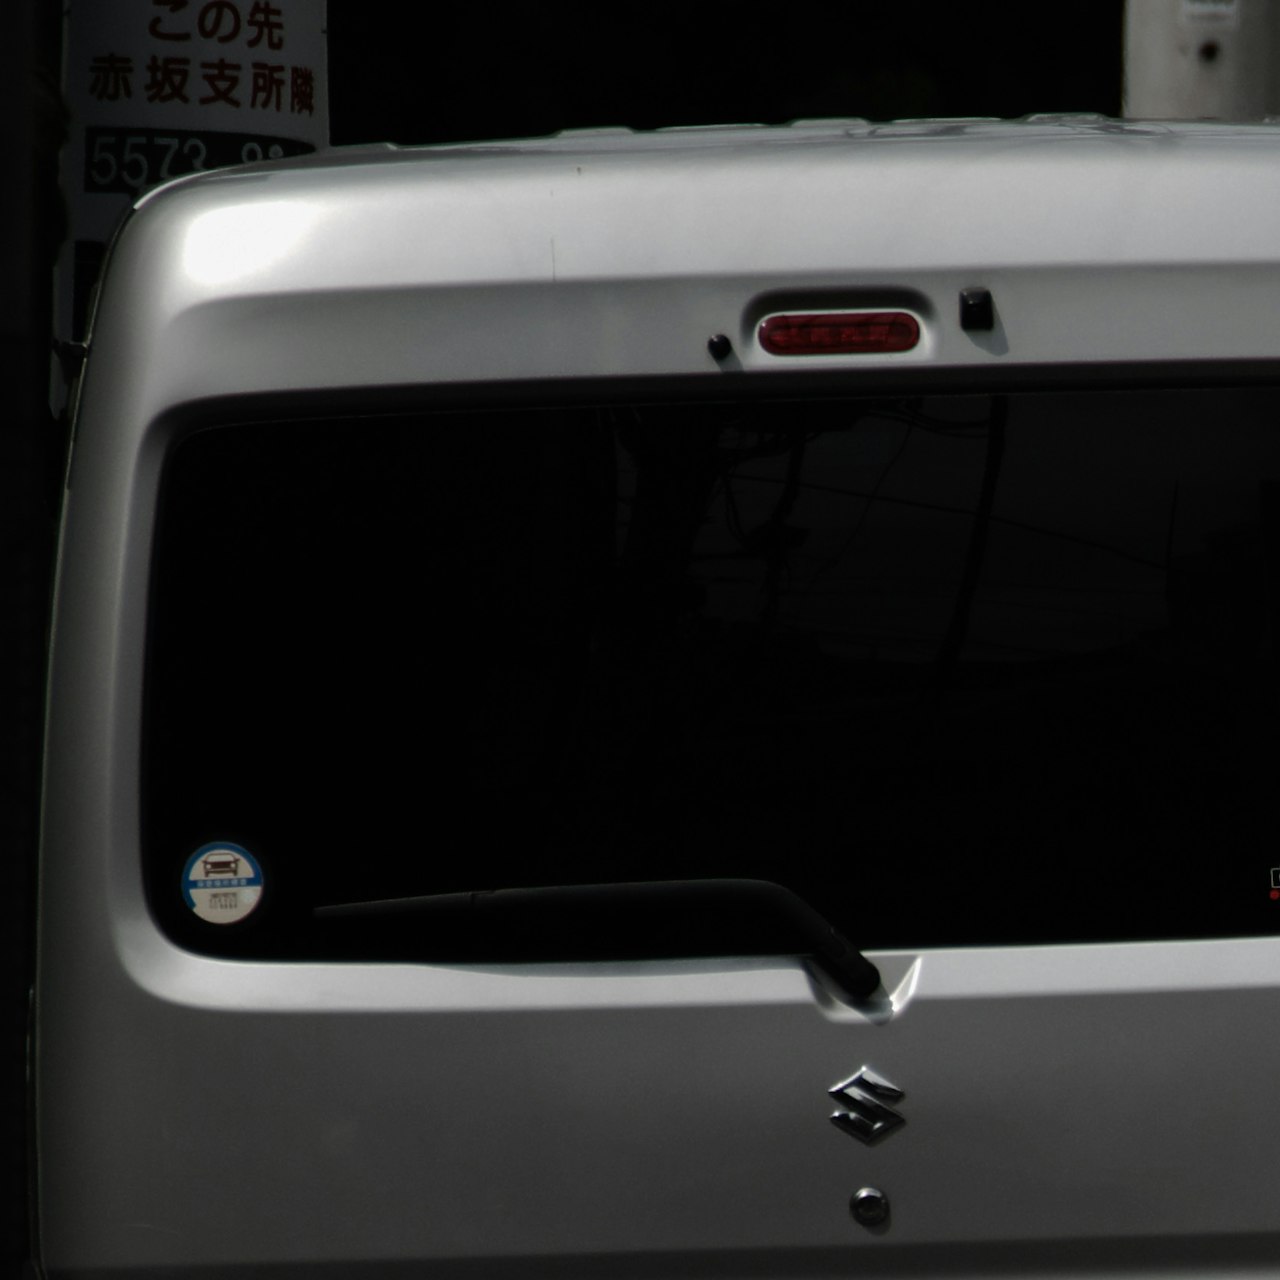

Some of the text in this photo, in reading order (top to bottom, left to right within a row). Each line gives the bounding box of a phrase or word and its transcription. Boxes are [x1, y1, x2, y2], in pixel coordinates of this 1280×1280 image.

[149, 0, 284, 49] この先
[89, 54, 314, 115] 赤坂支所隣
